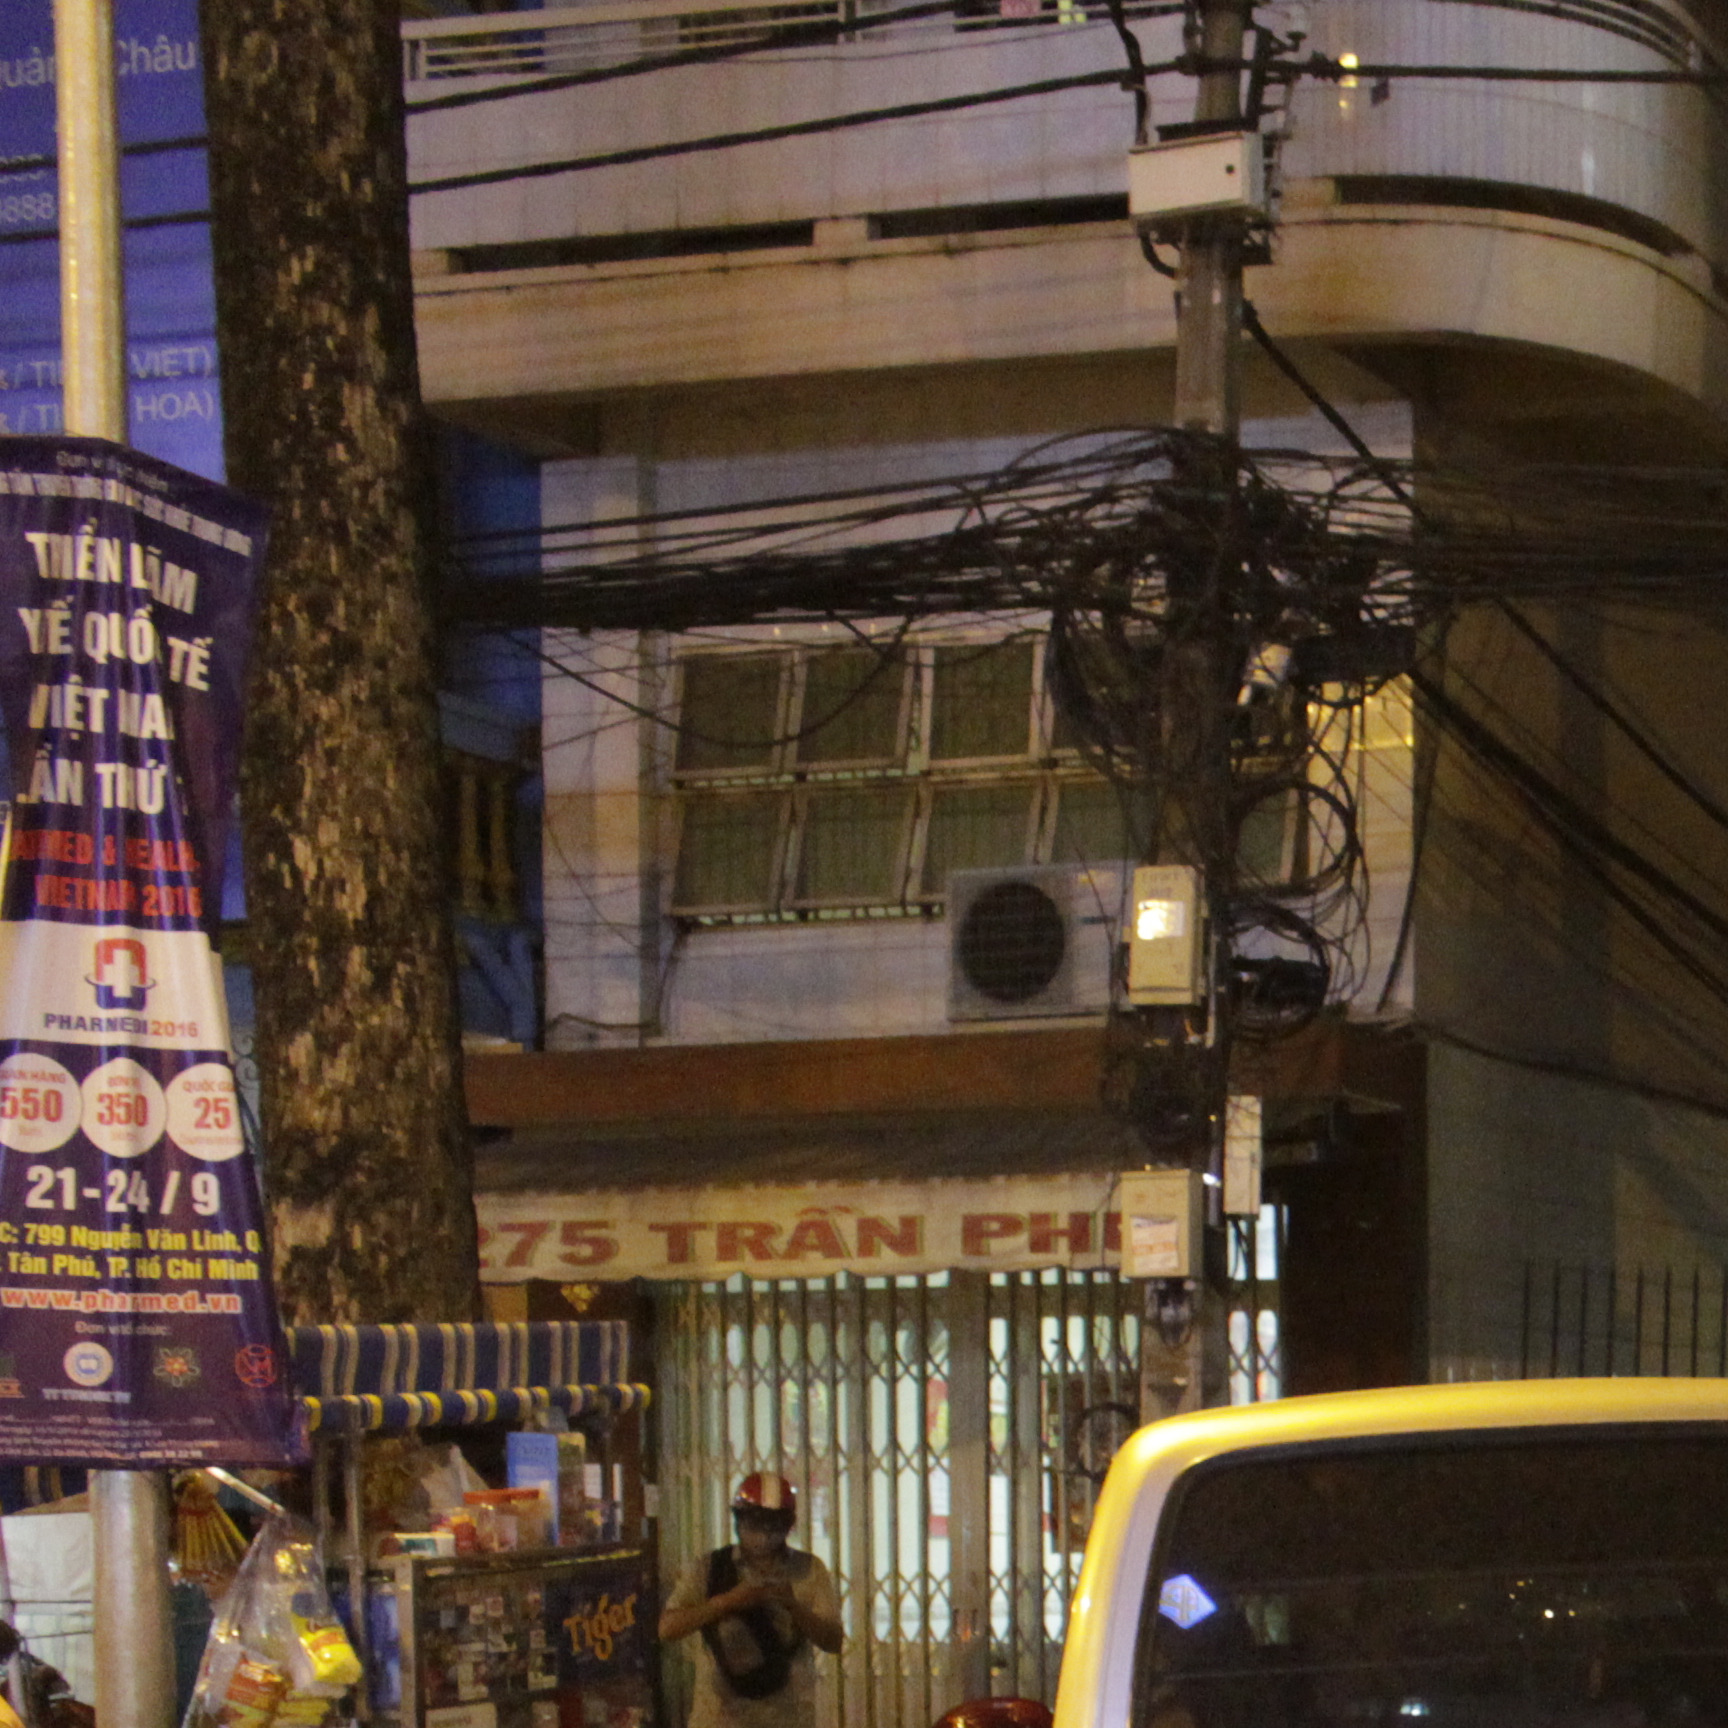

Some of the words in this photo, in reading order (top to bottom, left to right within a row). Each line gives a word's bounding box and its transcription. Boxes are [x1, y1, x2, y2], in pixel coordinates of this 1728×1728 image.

[0, 1086, 63, 1122] 550
[97, 1091, 148, 1127] 350
[194, 1097, 232, 1130] 25
[23, 1223, 66, 1246] 799
[146, 1228, 188, 1251] Văn
[648, 1205, 922, 1263] TRẦN
[7, 1251, 48, 1275] Tân
[208, 1257, 260, 1281] Minh
[563, 1593, 638, 1661] Tiger
